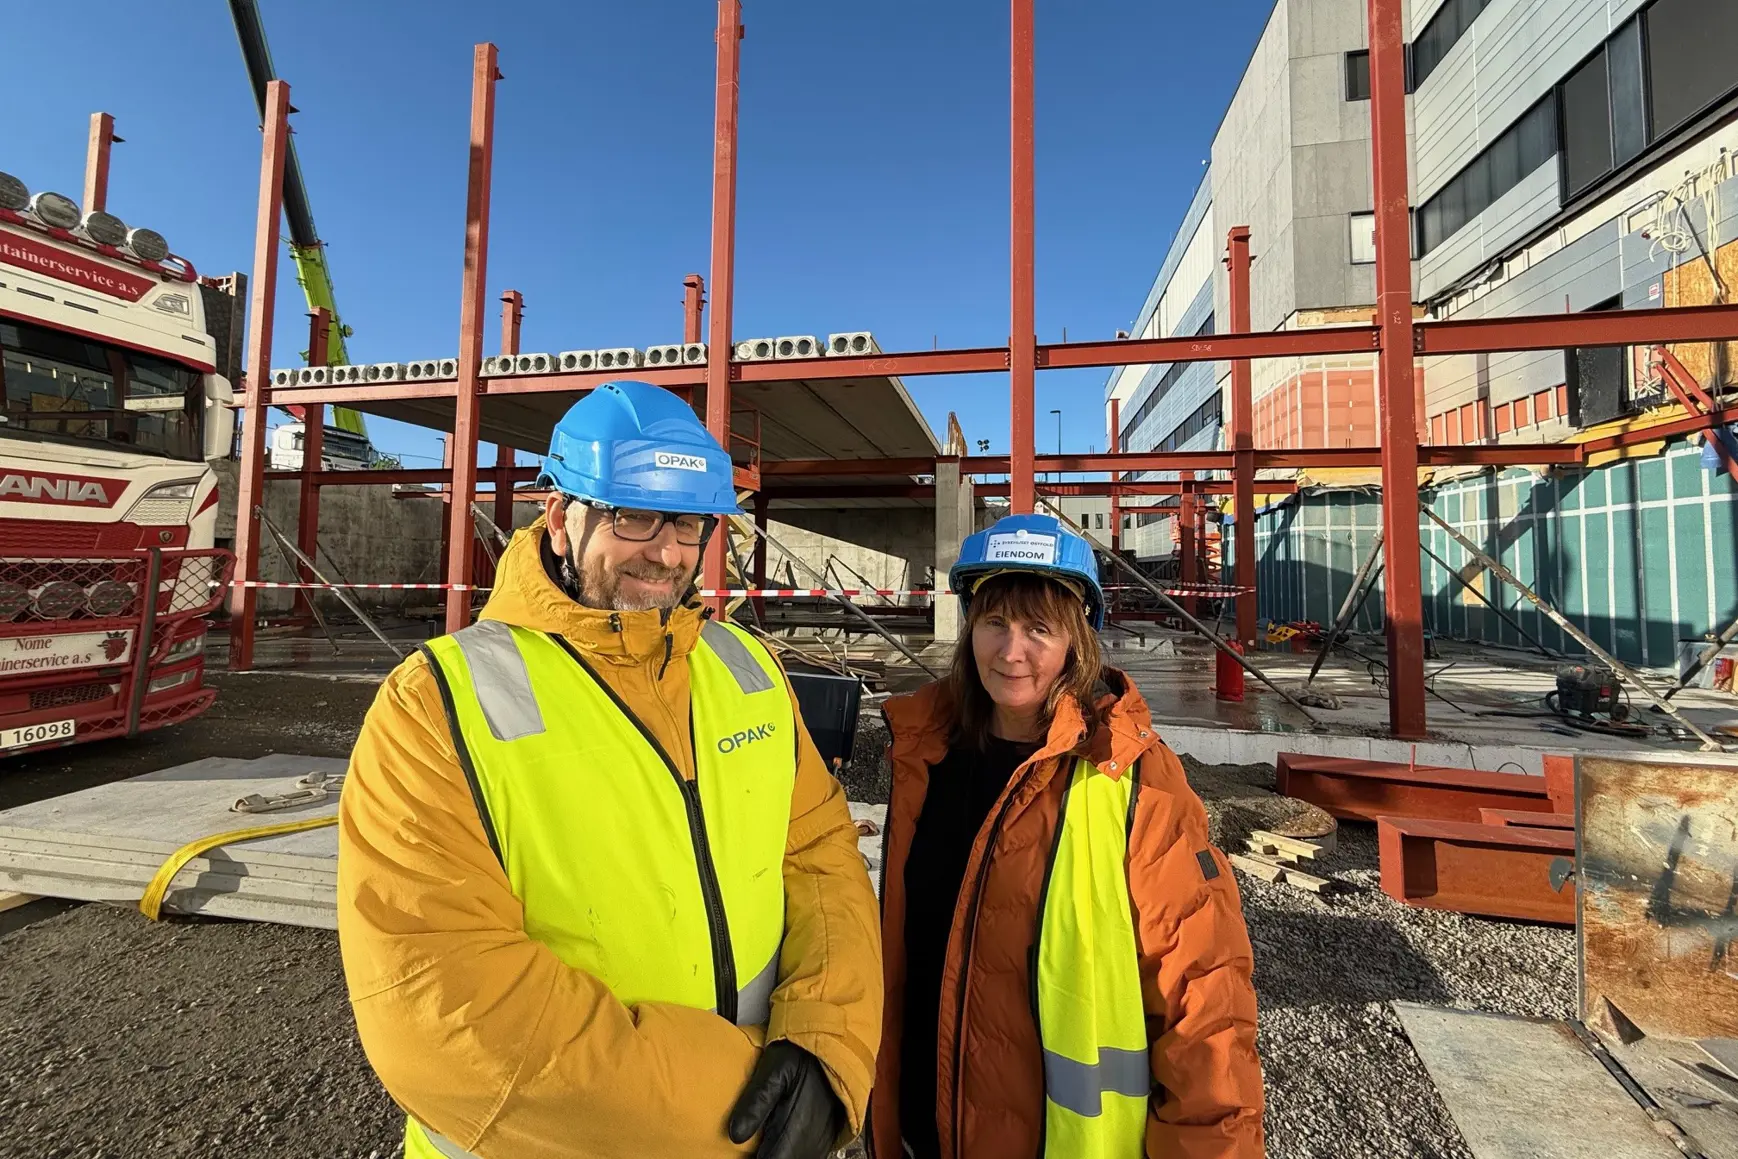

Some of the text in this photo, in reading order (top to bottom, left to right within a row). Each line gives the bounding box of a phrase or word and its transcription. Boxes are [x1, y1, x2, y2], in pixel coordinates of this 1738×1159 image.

[0, 243, 139, 295] tainerservice a.s
[658, 454, 700, 469] OPAK
[0, 474, 109, 503] ANIA
[995, 550, 1045, 560] EIENDOM
[14, 638, 53, 651] Nome
[0, 652, 92, 672] inerservice a.s
[13, 722, 72, 744] 16098
[717, 723, 772, 754] OPAK
